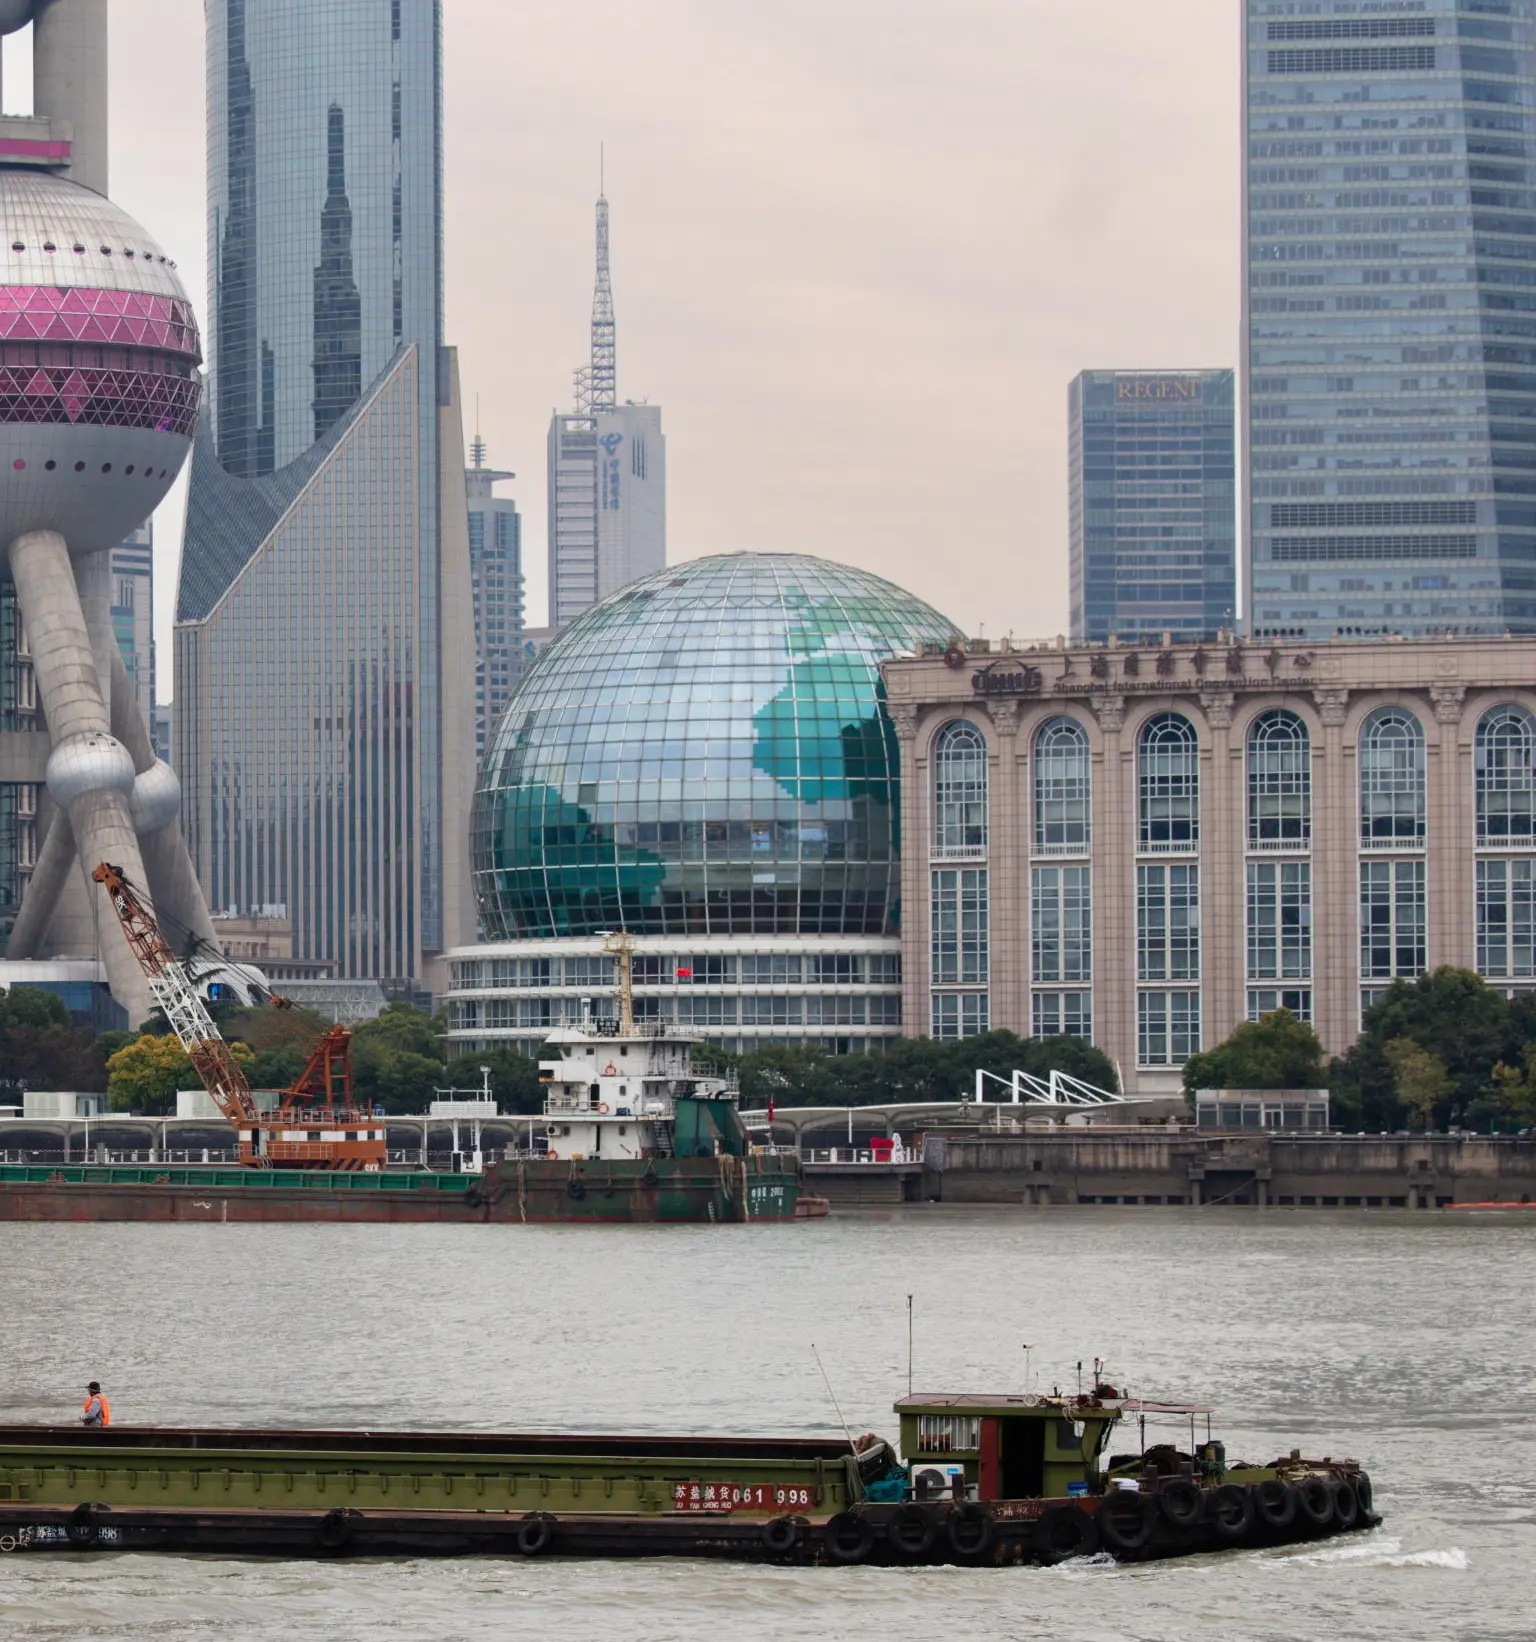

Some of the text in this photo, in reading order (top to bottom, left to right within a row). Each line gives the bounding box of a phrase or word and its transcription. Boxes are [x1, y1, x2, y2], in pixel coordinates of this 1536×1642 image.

[1118, 380, 1201, 398] REGENT
[1054, 681, 1107, 694] Shanghai
[1114, 679, 1191, 693] International
[1195, 676, 1267, 691] Convention
[1272, 674, 1314, 688] Center
